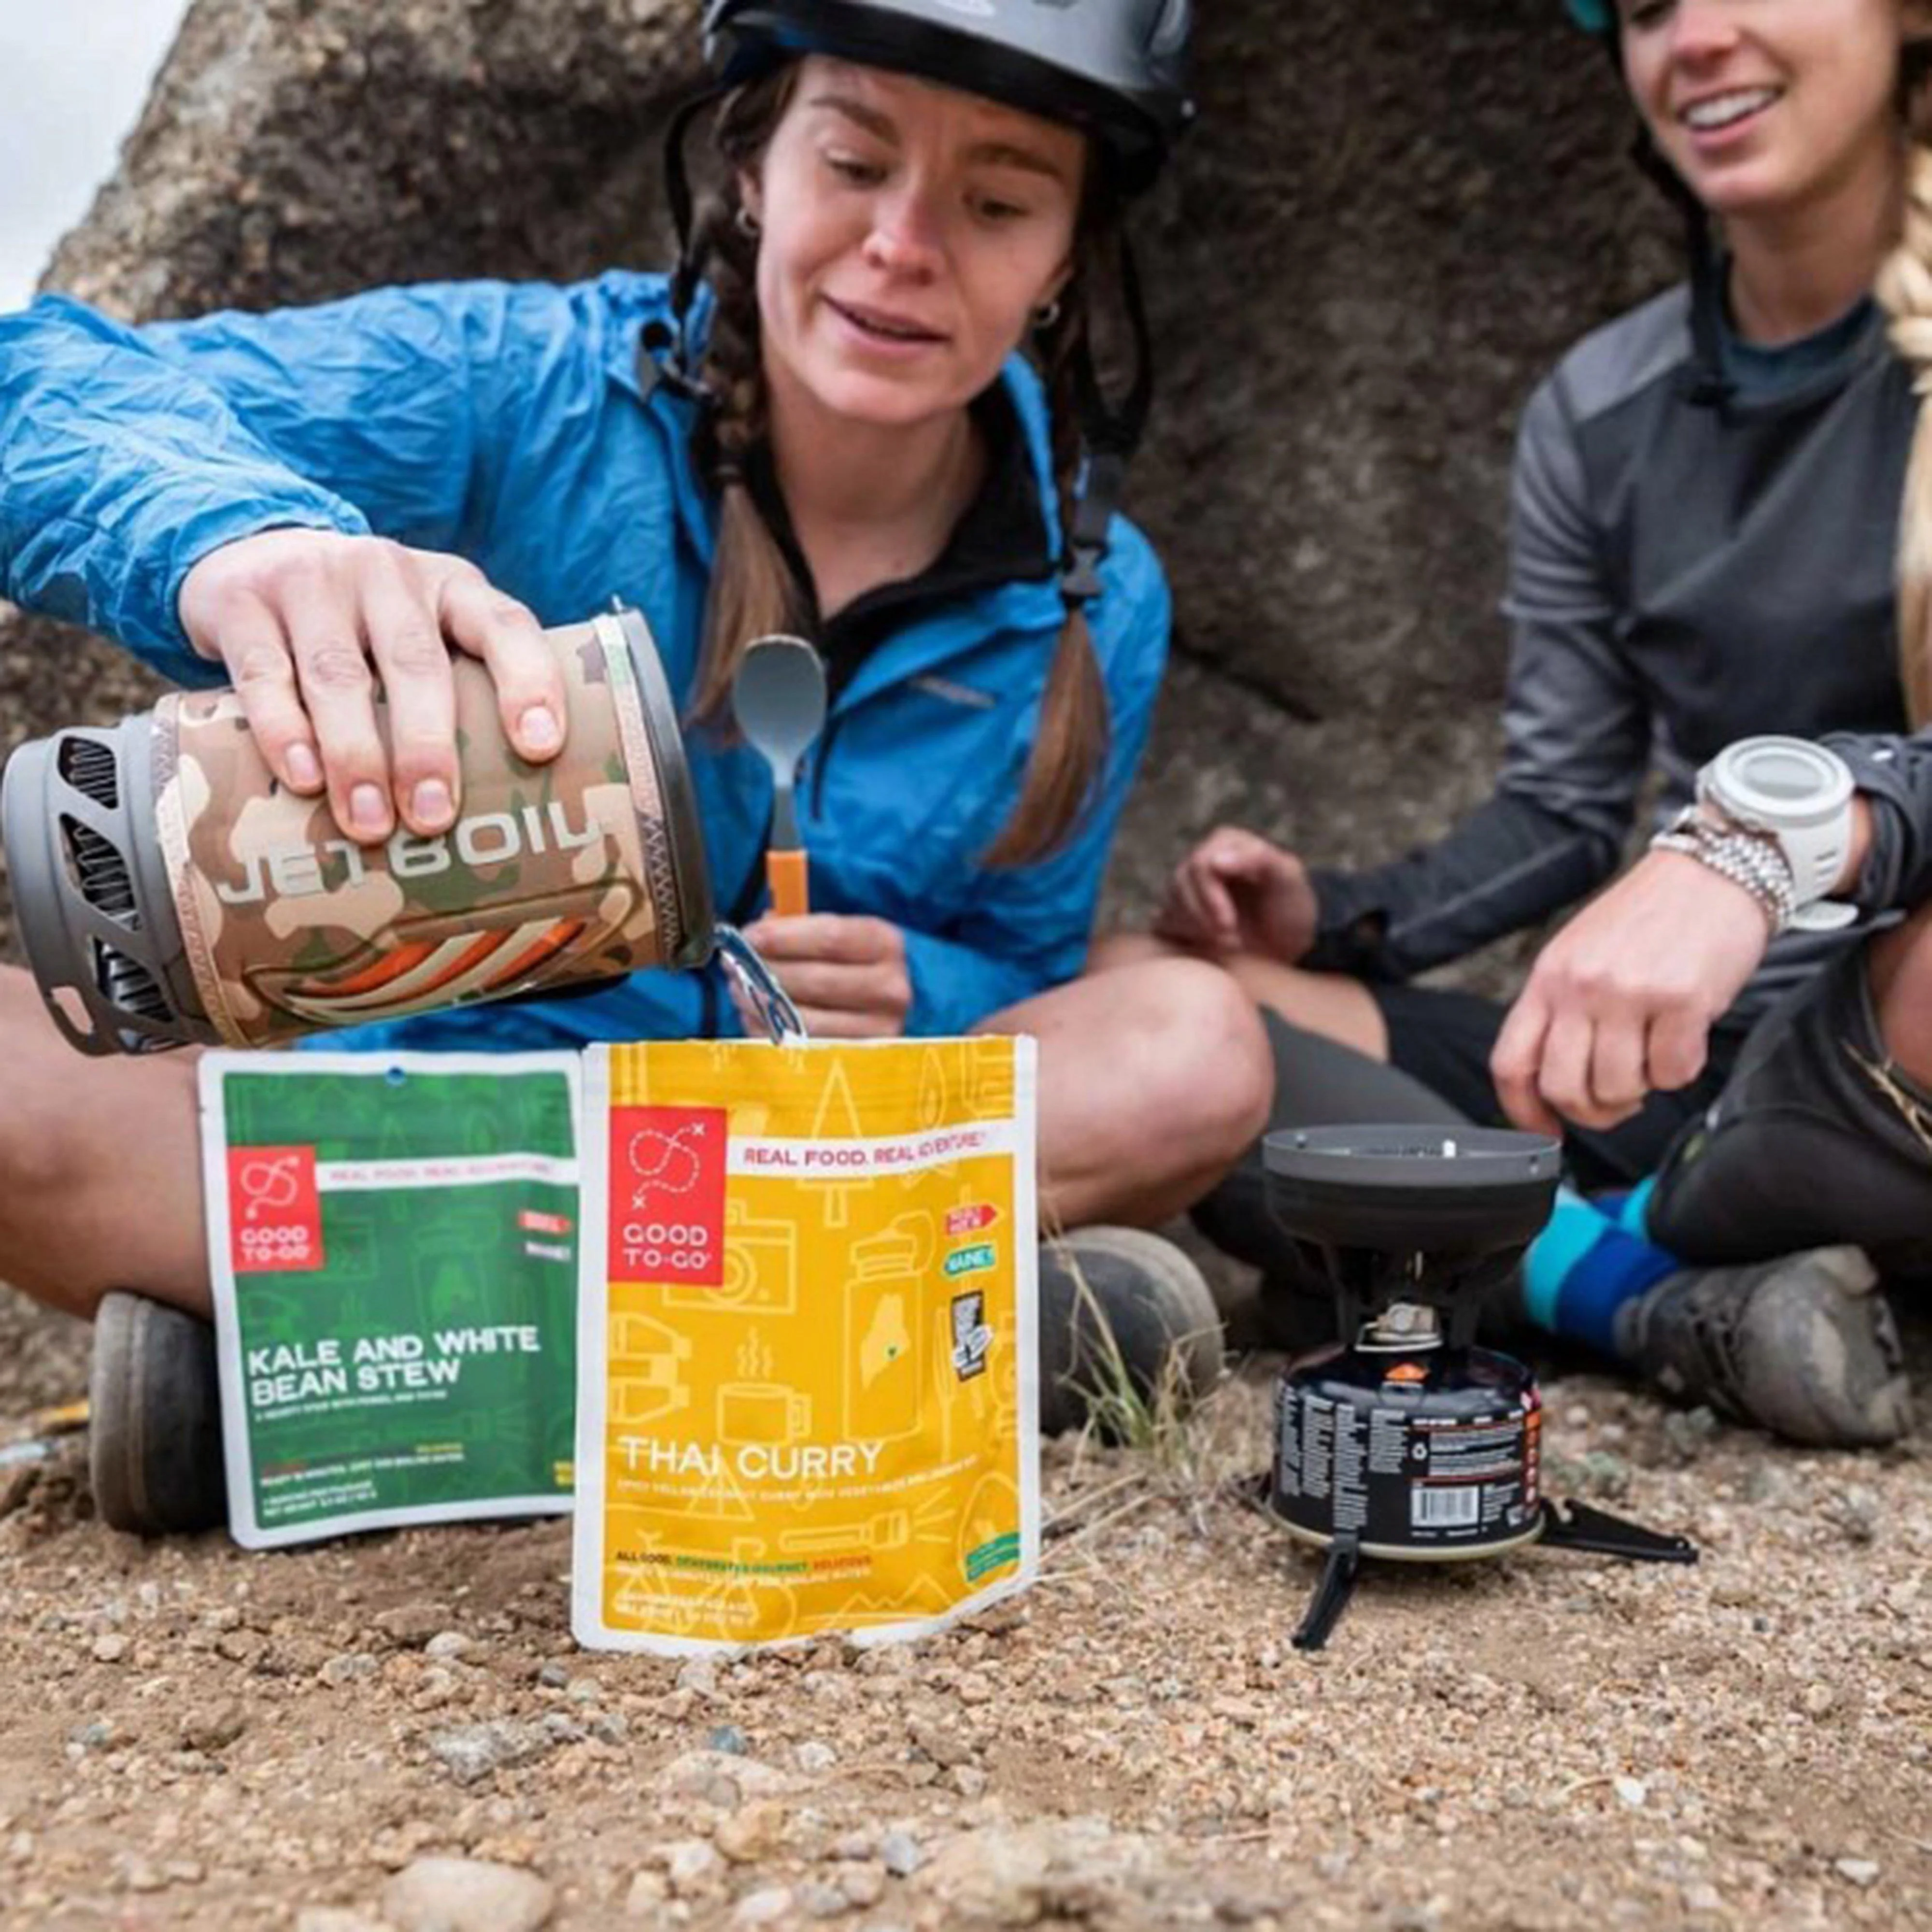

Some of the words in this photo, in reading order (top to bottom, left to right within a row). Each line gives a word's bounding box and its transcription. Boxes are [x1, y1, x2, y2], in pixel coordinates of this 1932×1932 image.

[743, 1148, 797, 1166] REAL
[874, 1145, 914, 1163] REAL
[241, 1225, 308, 1245] GOOD
[623, 1223, 708, 1247] GOOD
[249, 1340, 341, 1377] KALE
[353, 1335, 423, 1363] AND
[433, 1326, 540, 1352] WHITE
[252, 1369, 347, 1407] BEAN
[358, 1360, 460, 1390] STEW
[625, 1436, 721, 1475] THAI
[738, 1443, 883, 1479] CURRY
